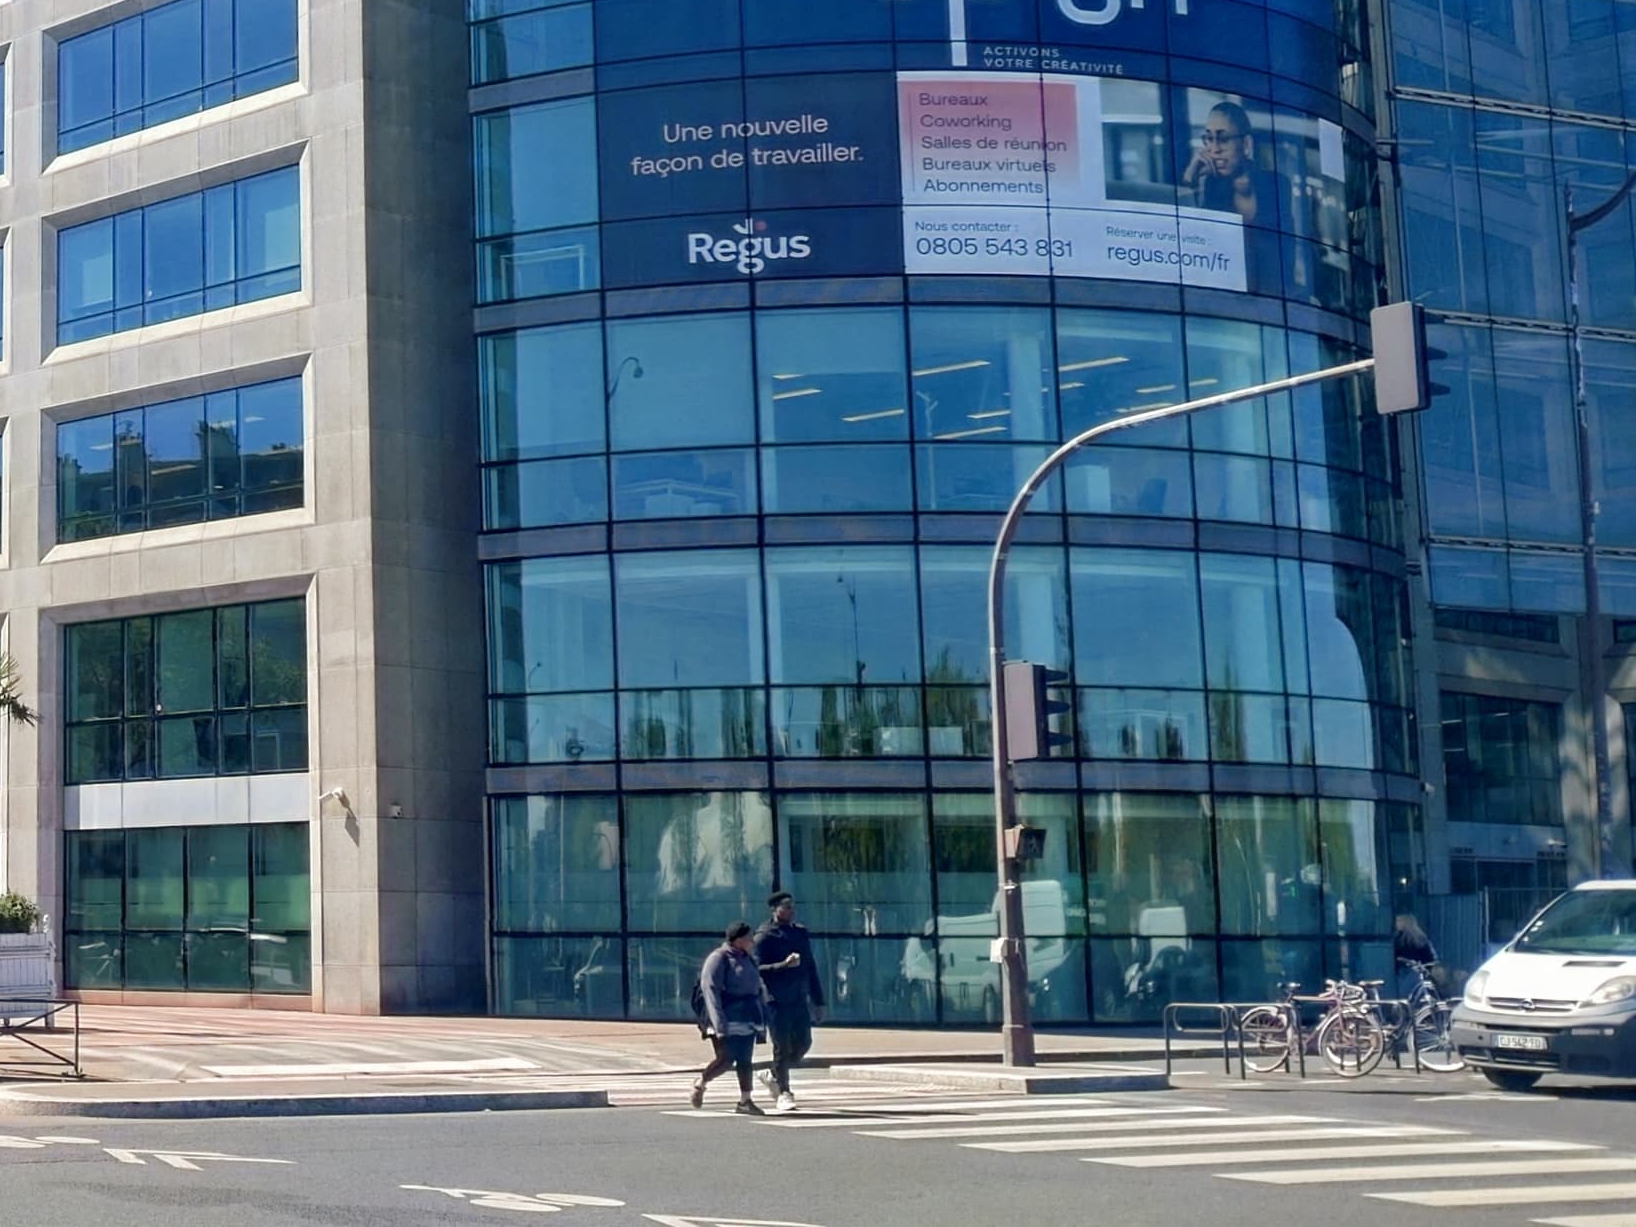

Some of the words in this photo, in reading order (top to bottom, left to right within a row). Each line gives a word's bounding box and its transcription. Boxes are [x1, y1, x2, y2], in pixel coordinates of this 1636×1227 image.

[983, 46, 1061, 58] ACTIVONS
[984, 58, 1034, 70] VOTRE
[1042, 59, 1123, 74] CRÉATIVITÉ
[919, 92, 988, 106] Bureaux
[663, 124, 713, 143] Une
[721, 114, 829, 139] nouvelle
[920, 114, 1012, 131] Coworking
[921, 136, 972, 150] Salles
[976, 136, 998, 150] de
[1004, 136, 1067, 152] réunion
[631, 155, 703, 178] façon
[711, 149, 744, 169] de
[752, 143, 864, 166] travailler.
[923, 157, 992, 171] Bureaux
[924, 179, 1044, 194] Abonnements
[915, 221, 948, 232] Nous
[951, 221, 1011, 232] contacter
[1106, 226, 1153, 239] Réserver
[1156, 232, 1177, 241] une
[687, 230, 811, 274] Regus
[916, 237, 978, 255] 0805
[985, 238, 1028, 256] 543
[1035, 239, 1073, 258] 831
[1107, 244, 1231, 272] regus.com/fr
